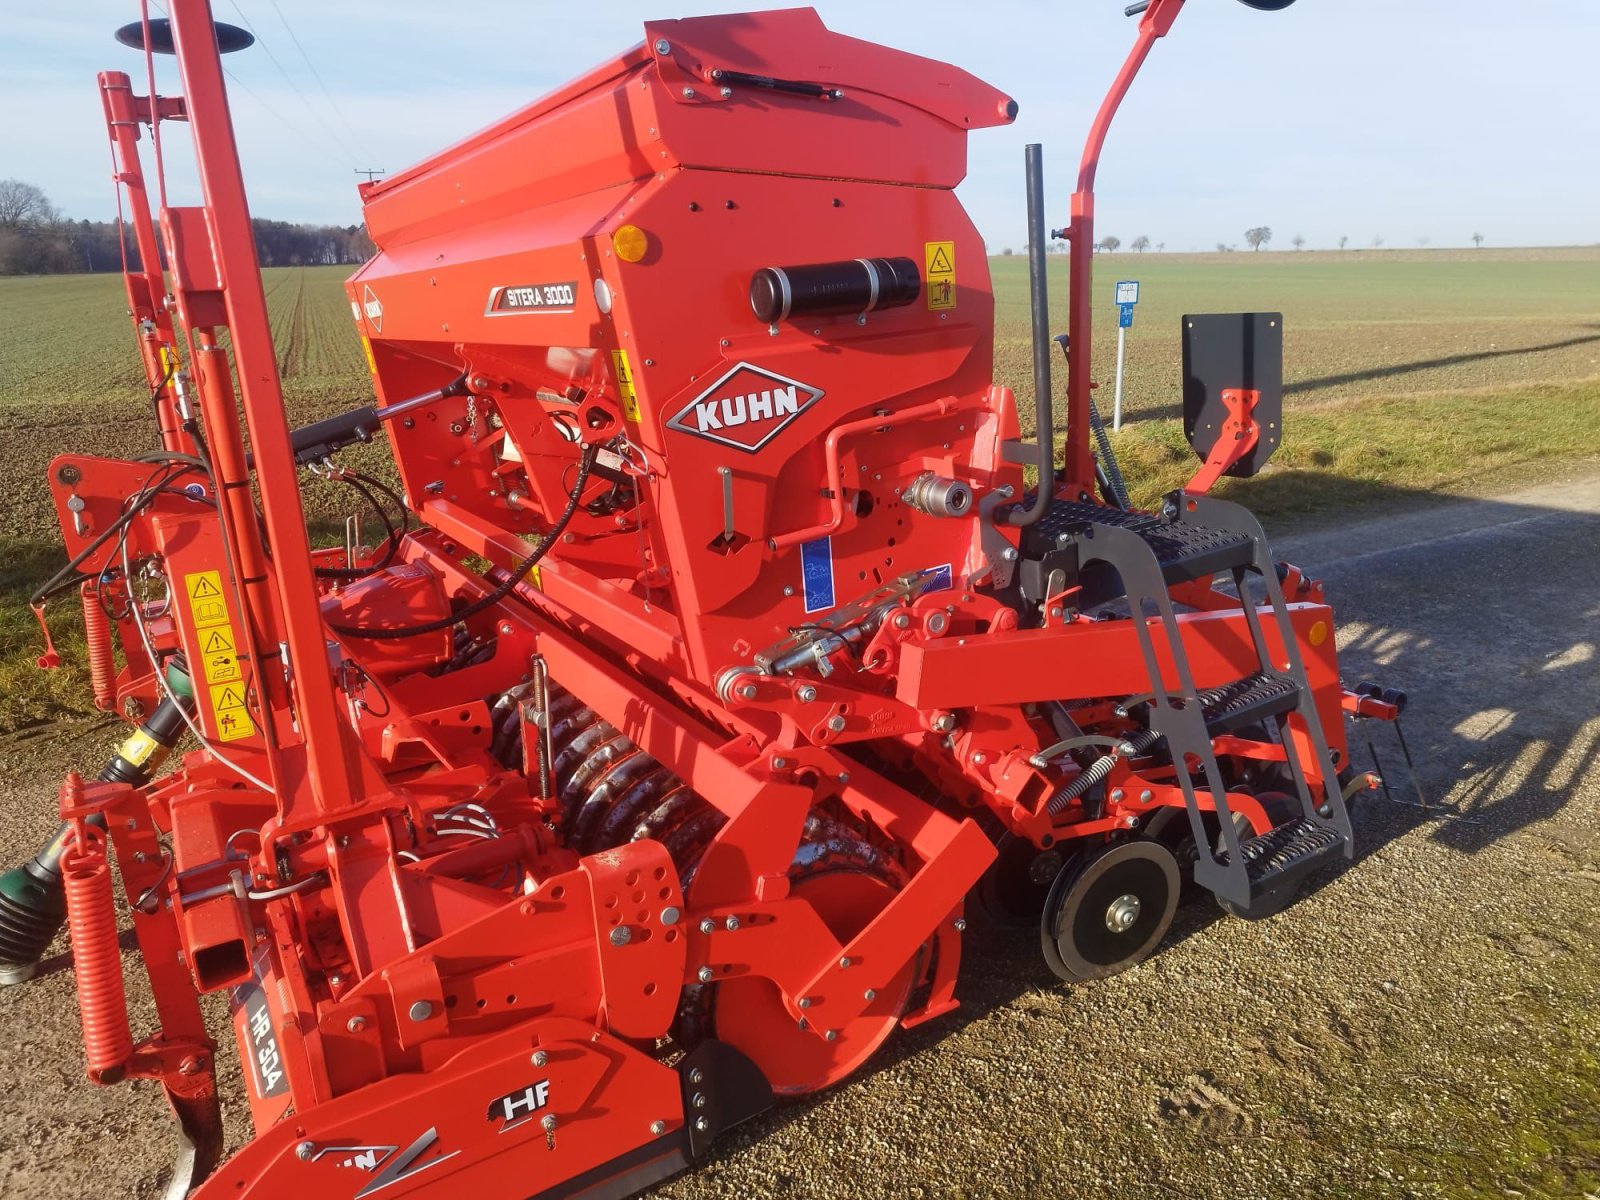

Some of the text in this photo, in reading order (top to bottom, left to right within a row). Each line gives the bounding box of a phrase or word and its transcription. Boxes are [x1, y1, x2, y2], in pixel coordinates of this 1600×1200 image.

[507, 285, 574, 306] SITERA 3000
[695, 385, 798, 432] KUHN
[250, 1004, 283, 1094] HR 304
